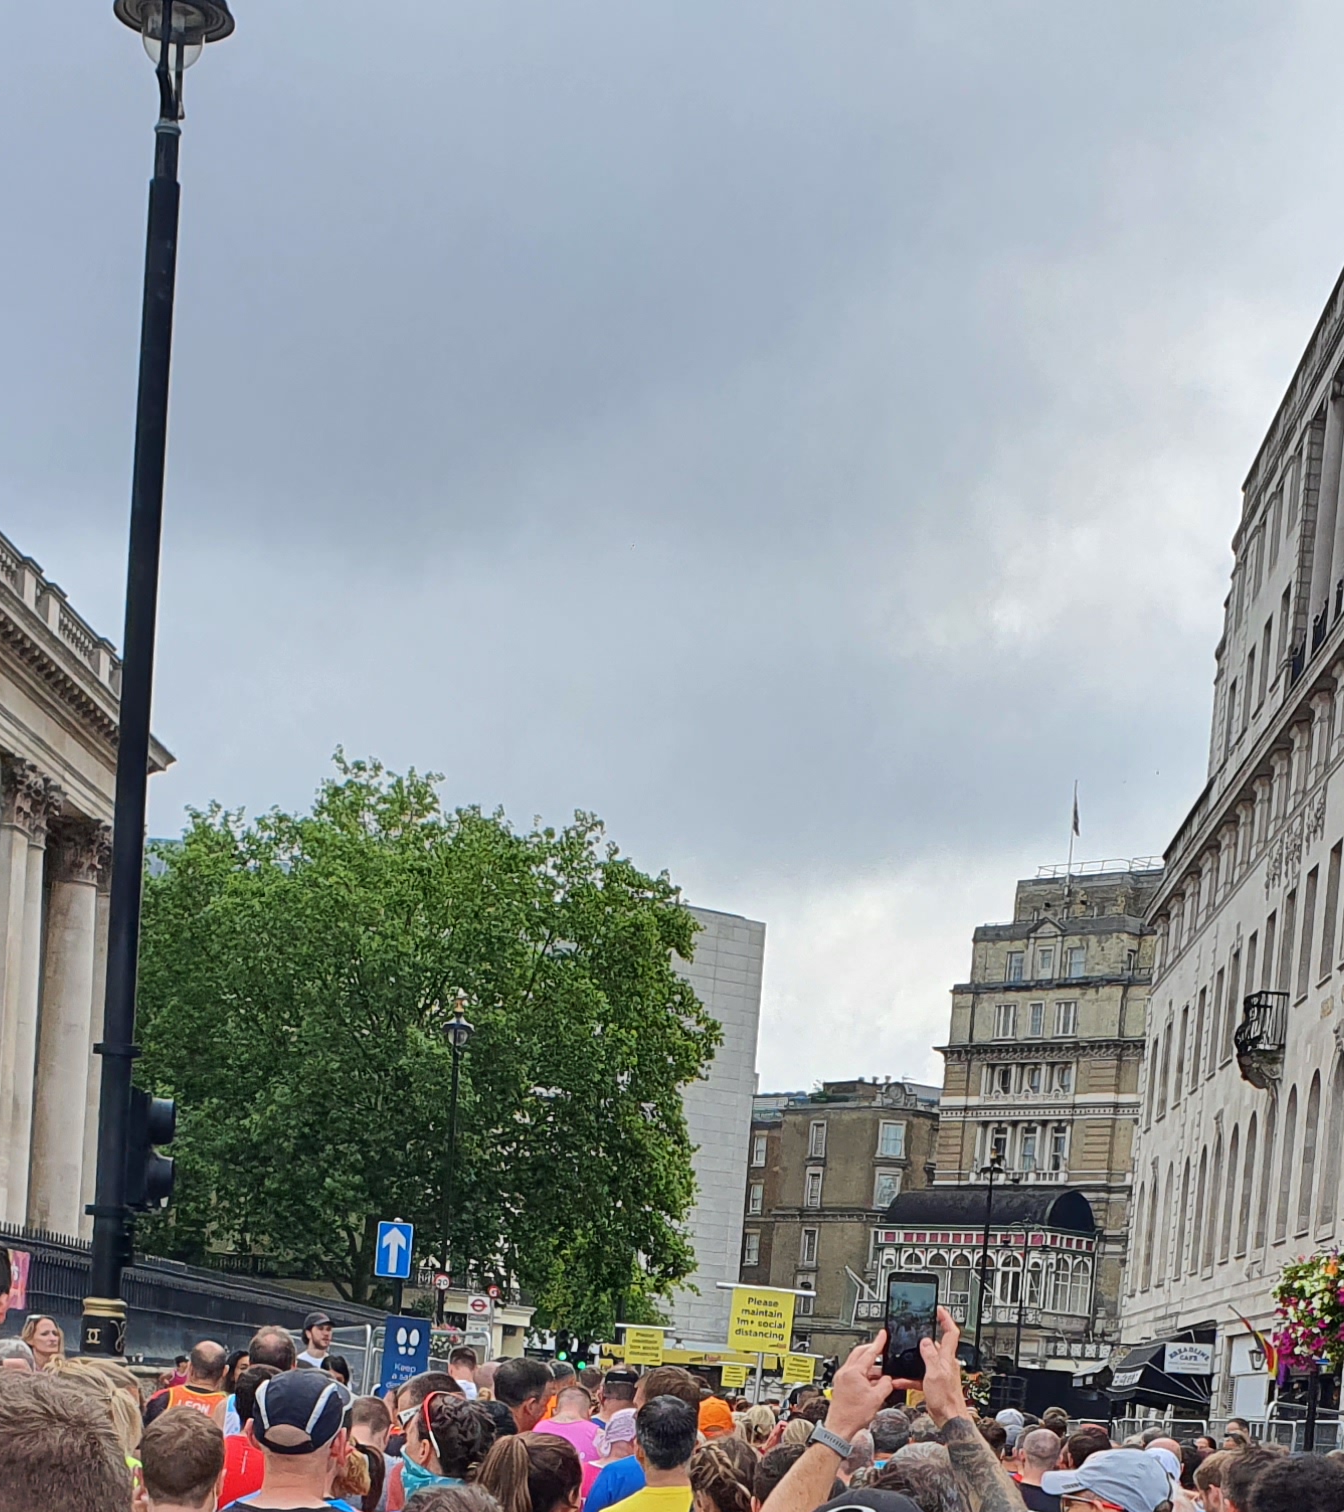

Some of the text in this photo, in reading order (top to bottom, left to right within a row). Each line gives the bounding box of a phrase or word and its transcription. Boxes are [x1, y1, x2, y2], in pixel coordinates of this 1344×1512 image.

[747, 1296, 779, 1308] Please
[741, 1308, 783, 1319] maintain
[736, 1317, 786, 1330] 1m+ social
[734, 1328, 785, 1341] distancing
[394, 1363, 416, 1373] Keep
